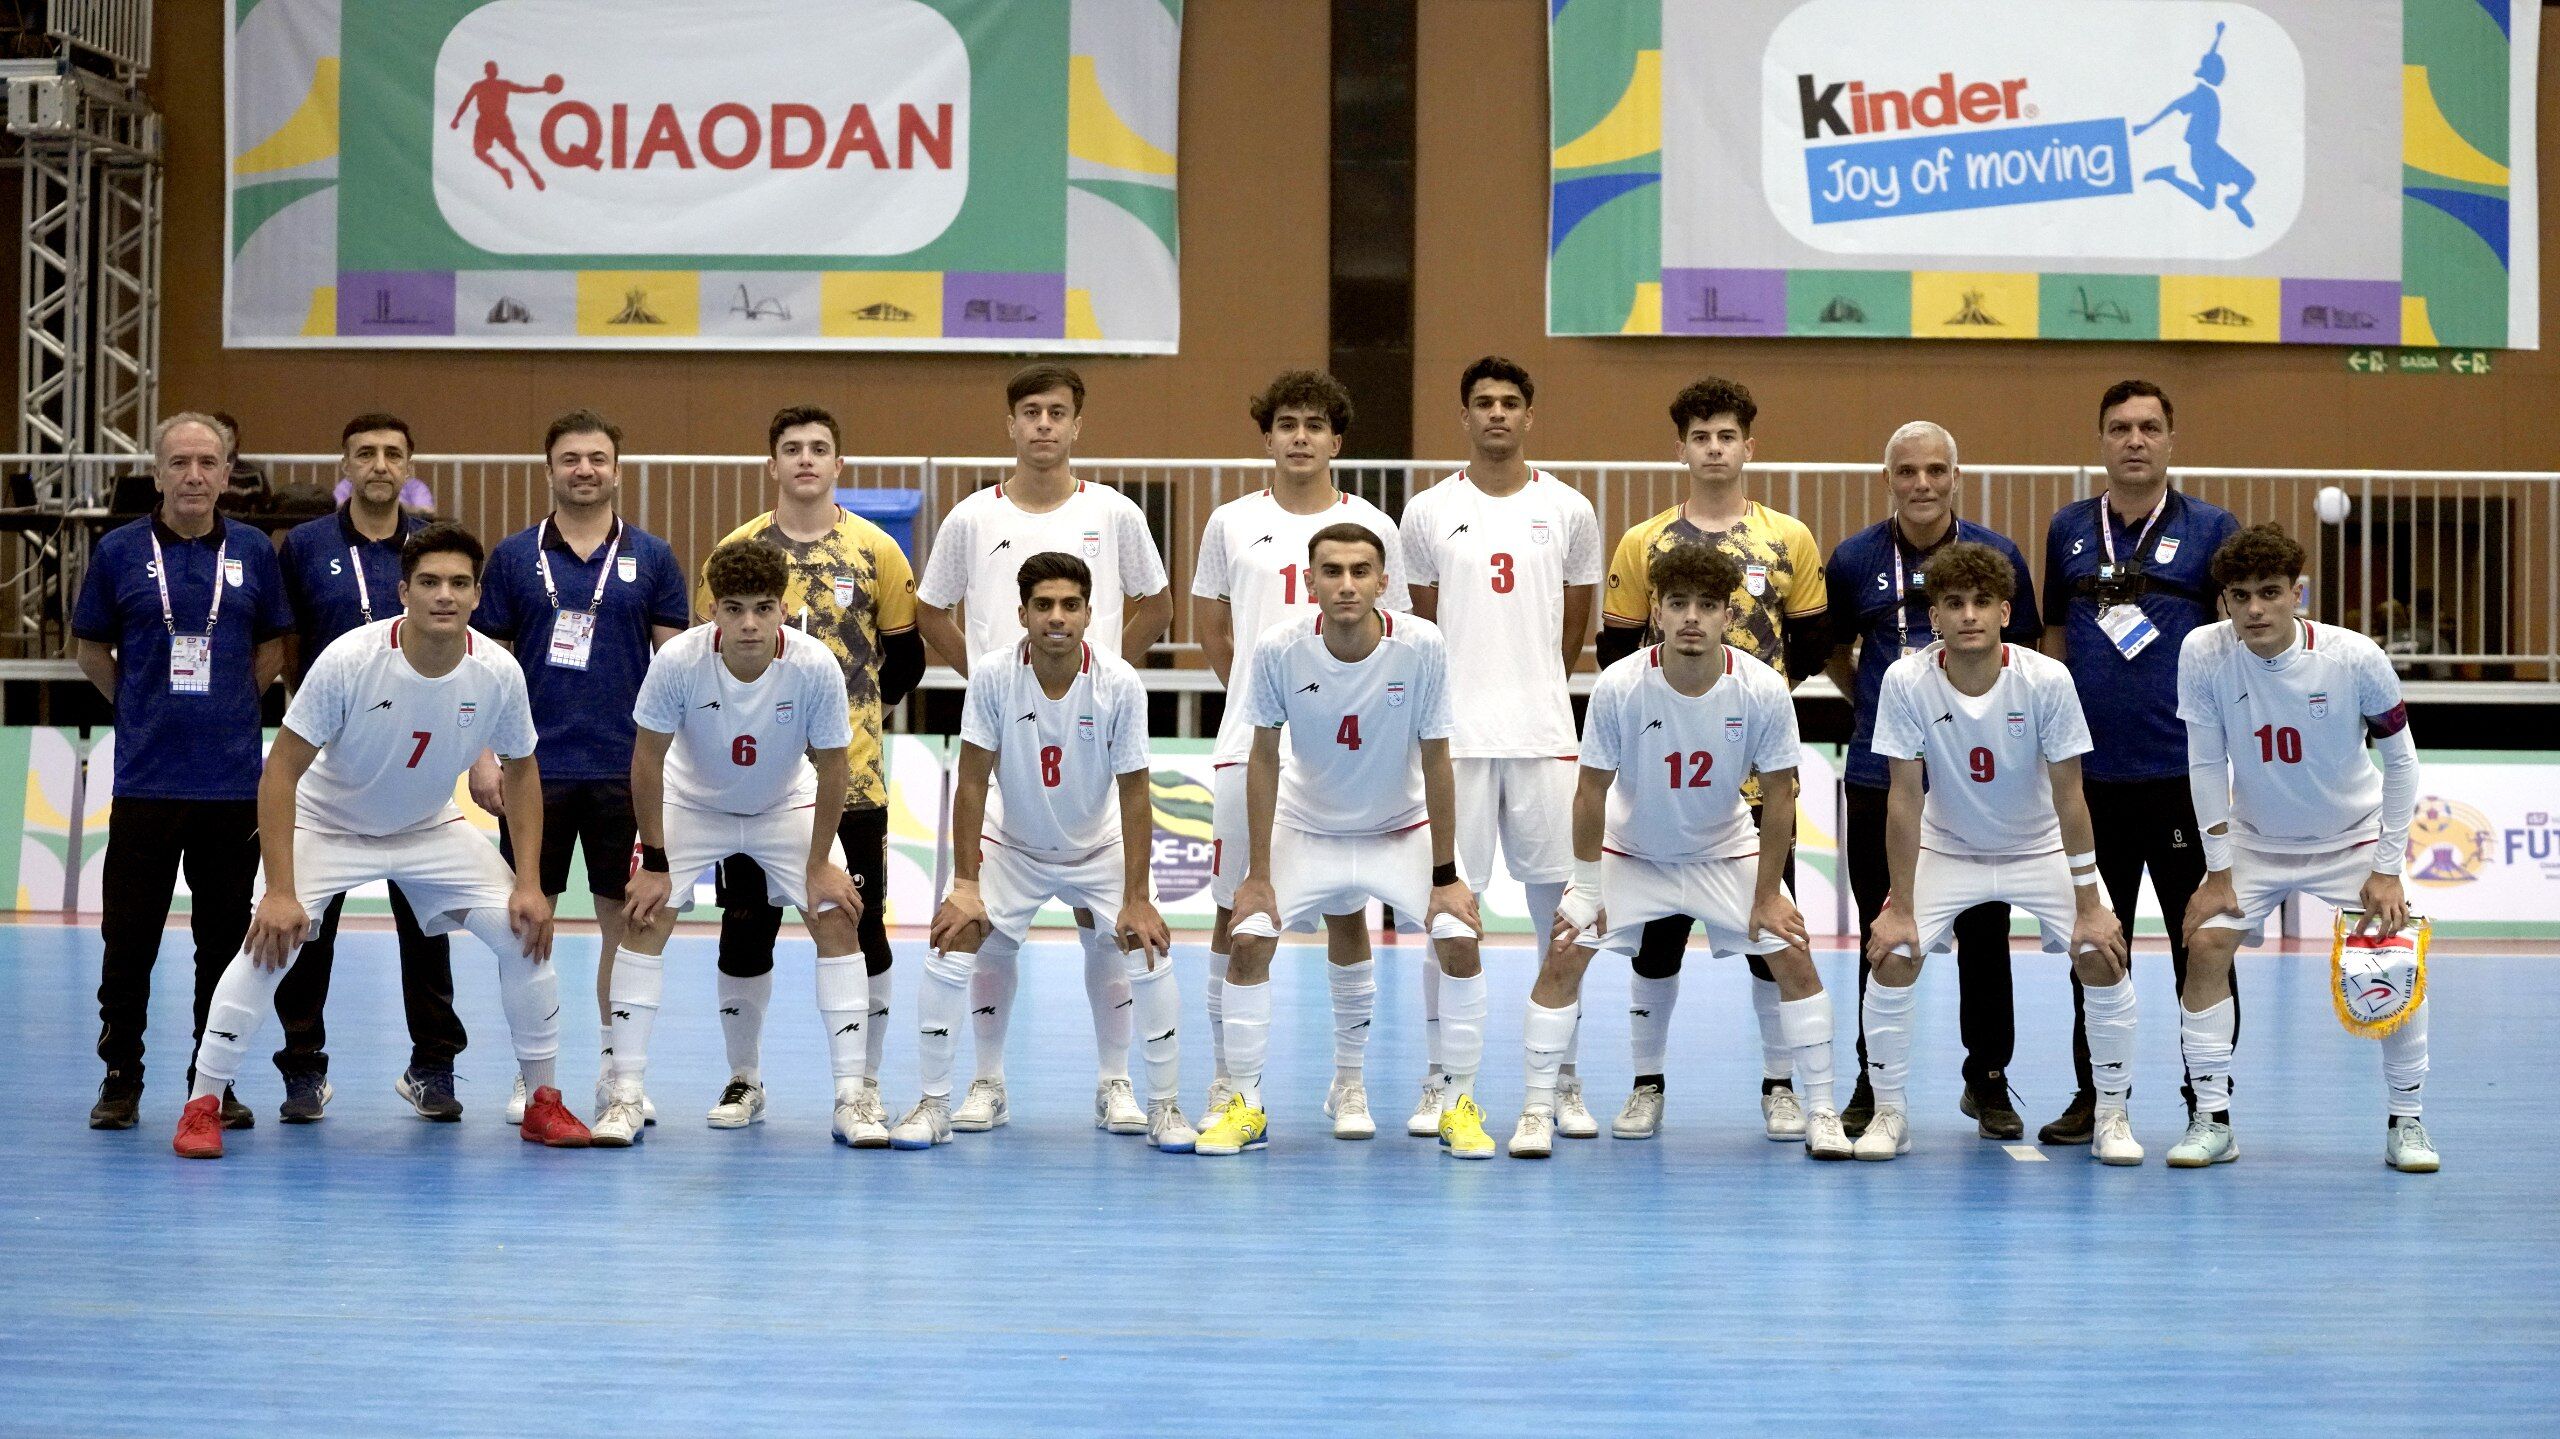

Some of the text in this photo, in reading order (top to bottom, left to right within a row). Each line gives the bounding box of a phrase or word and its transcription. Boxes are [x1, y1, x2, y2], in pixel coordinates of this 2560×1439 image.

[540, 101, 953, 171] QIAODAN
[1823, 138, 2116, 208] Joy of moving
[1490, 552, 1515, 594] 3
[406, 731, 431, 768] 7
[732, 735, 757, 766] 6
[1336, 715, 1362, 751] 4
[2255, 725, 2302, 763] 10
[1039, 745, 1063, 788] 8
[1665, 750, 1714, 789] 12
[1970, 746, 1995, 782] 9
